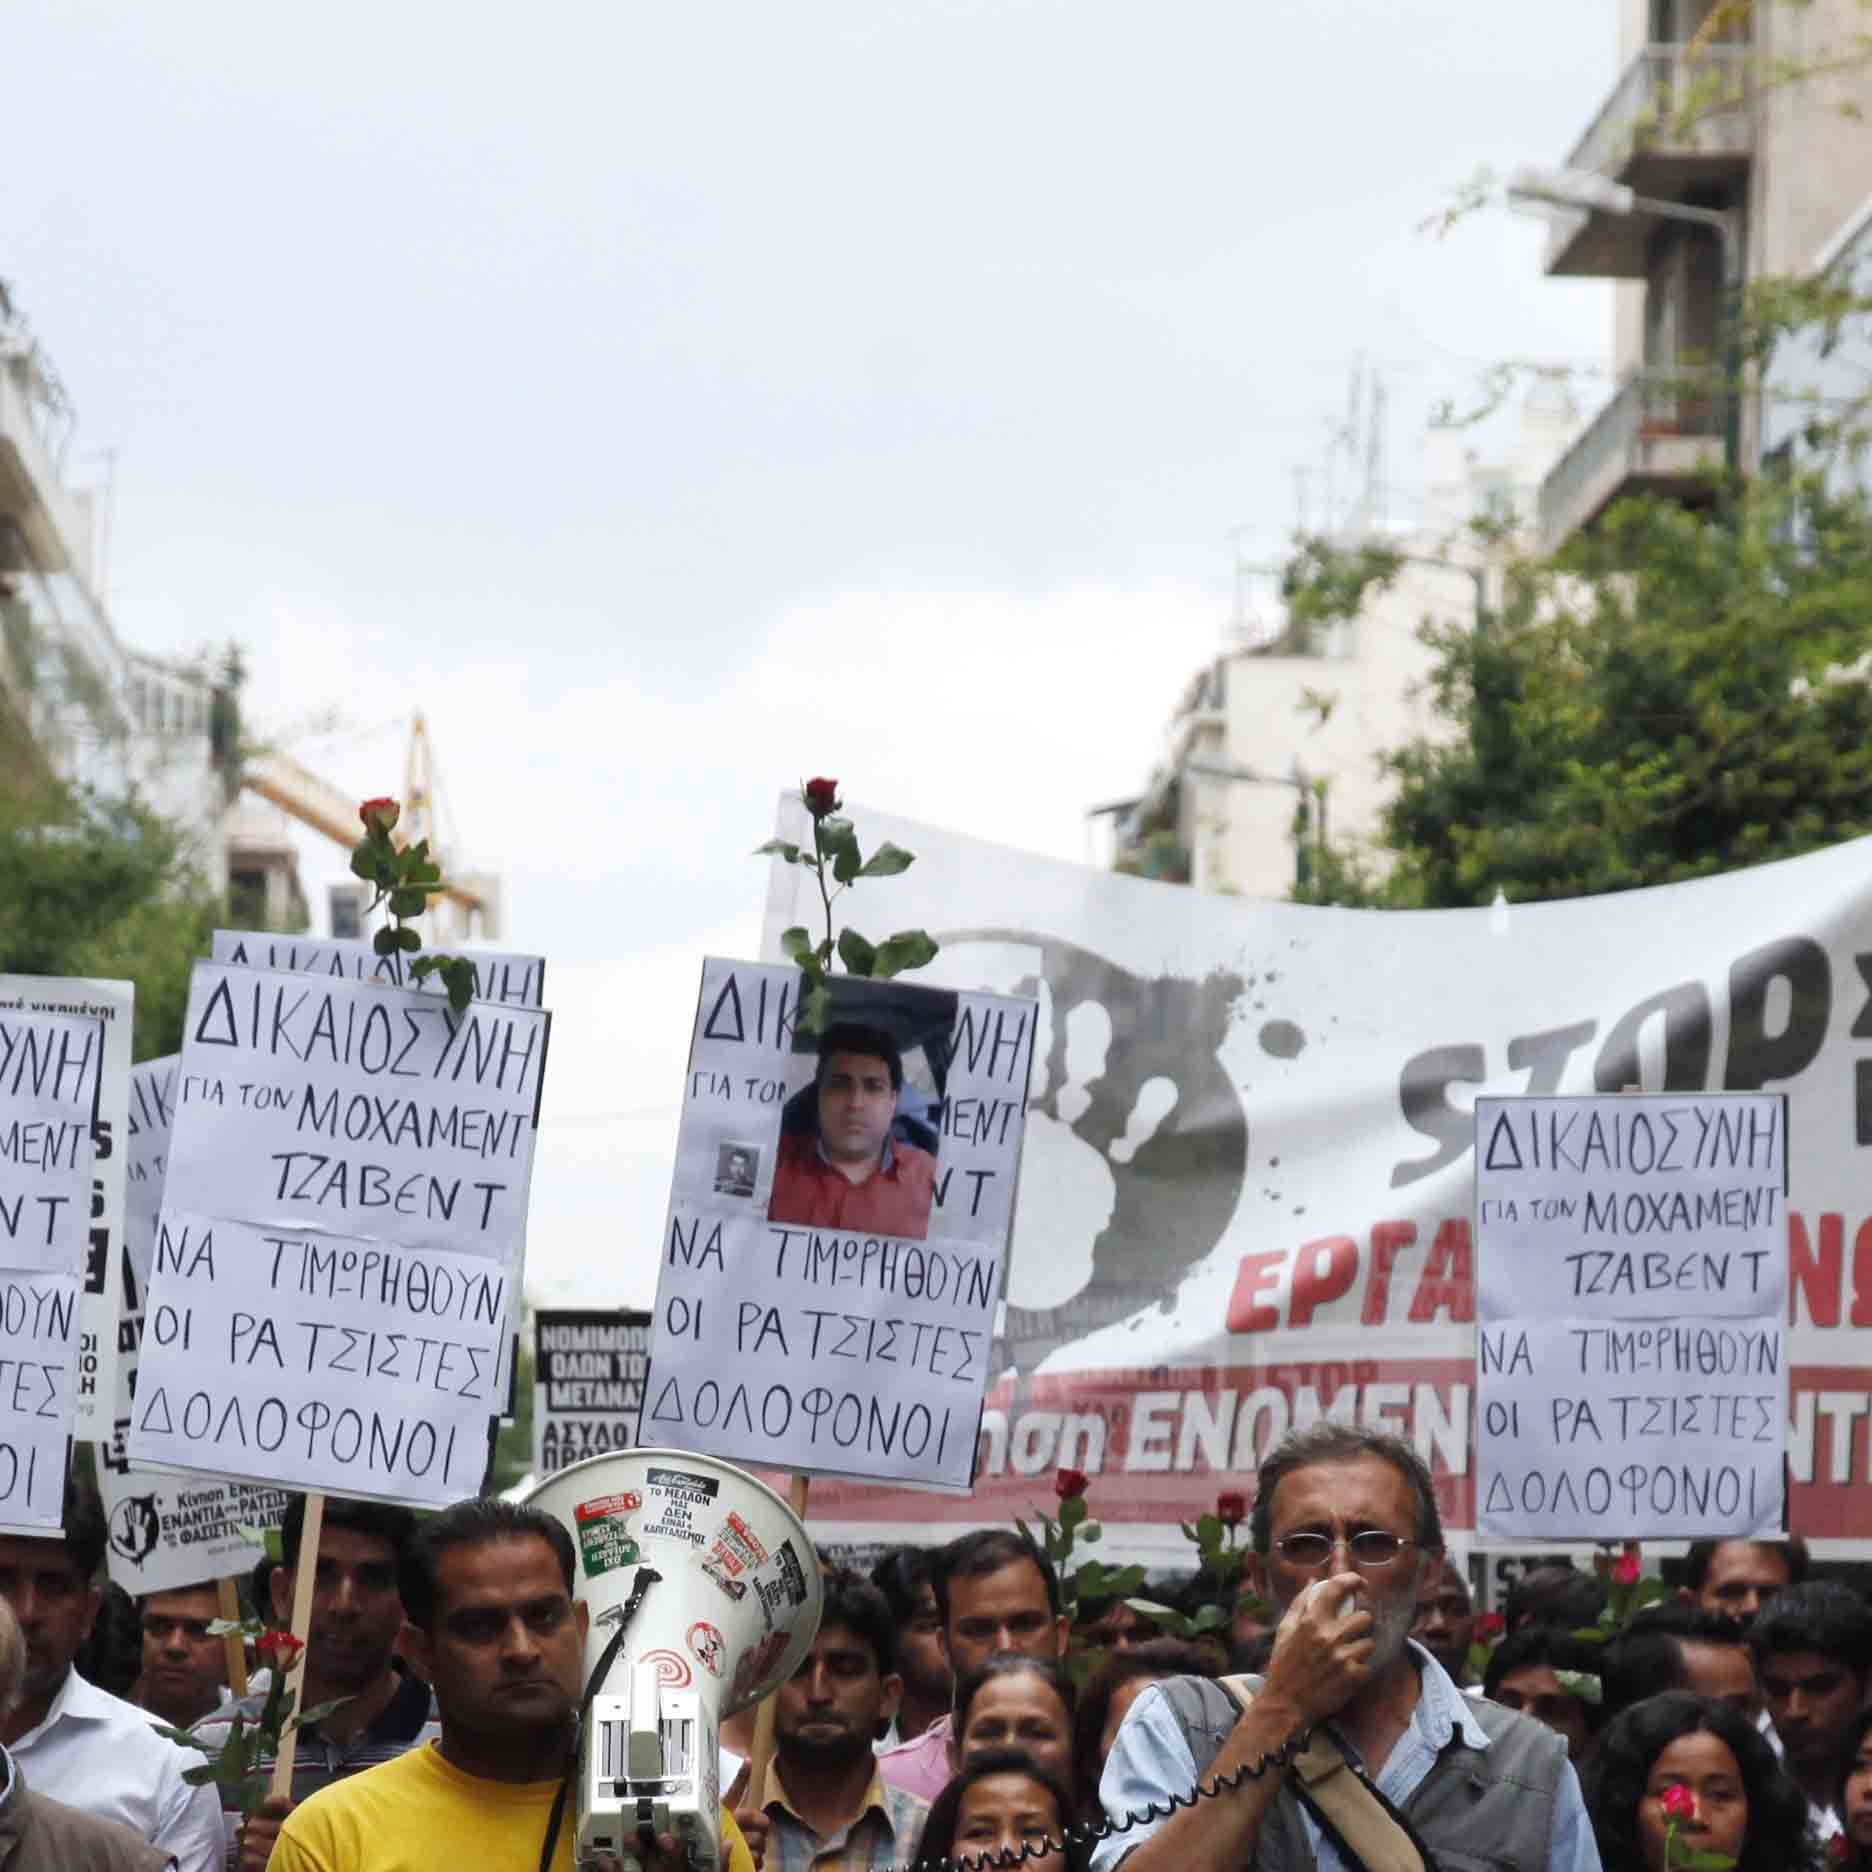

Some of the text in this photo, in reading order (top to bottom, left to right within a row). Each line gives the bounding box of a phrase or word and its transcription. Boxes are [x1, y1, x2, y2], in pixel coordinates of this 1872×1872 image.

[195, 976, 537, 1095] ΔΙΚΑΙΟΣΥΝΗ
[1389, 935, 1832, 1189] STOP
[692, 1072, 731, 1099] ΓΙΑ
[183, 1075, 224, 1104] ΓΙΑ
[239, 1083, 294, 1110] ΤΟΝ
[296, 1083, 528, 1159] ΜΟΧΑΜΕΝΤ
[1485, 1105, 1778, 1174] ΔΙΚΑΙΟΣΥΝΗ
[272, 1152, 506, 1230] ΤΖΑΒΕΝΤ
[1481, 1186, 1781, 1235] ΓΙΑ ΤΟΝ ΜΟΧΑΜΕΝΤ
[157, 1223, 504, 1325] ΝΑ ΤΙΜΩΡΗΘΟΥΝ
[670, 1216, 996, 1310] ΝΑ ΤΙΜΩΡΗΘΟΥΝ
[1564, 1250, 1770, 1297] ΤΖΑΒΕΝΤ
[154, 1305, 490, 1399] ΟΙ ΡΑΤΣΙΣΤΕΣ
[551, 1352, 612, 1380] ΟΛΩΝ
[666, 1297, 983, 1382] ΟΙ ΡΑΤΣΙΣΤΕΣ
[1480, 1328, 1780, 1376] ΝΑ ΤΙΜΩΡΗΘΟΥΝ
[139, 1387, 456, 1484] ΔΟΛΟΦΟΝΟΙ
[543, 1420, 628, 1447] ΑΣΥΛΟ
[651, 1376, 950, 1465] ΔΟΛΟΦΟΝΟΙ
[977, 1407, 1107, 1475] ηση
[1486, 1394, 1776, 1444] ΟΙ ΡΑΤΣΙΣΤΕΣ
[161, 1506, 225, 1531] ΕΝΑΝΤΙΑ
[664, 1507, 692, 1520] ΔΕΝ
[665, 1488, 711, 1506] ΜΕΛΛΟΝ
[1485, 1465, 1757, 1519] ΔΟΛΟΦΟΝΟΙ
[643, 1524, 706, 1545] ΚΑΠΙΤΑΛΙΣΜΟΣ
[661, 1517, 686, 1528] ΕΙΝΑΙ
